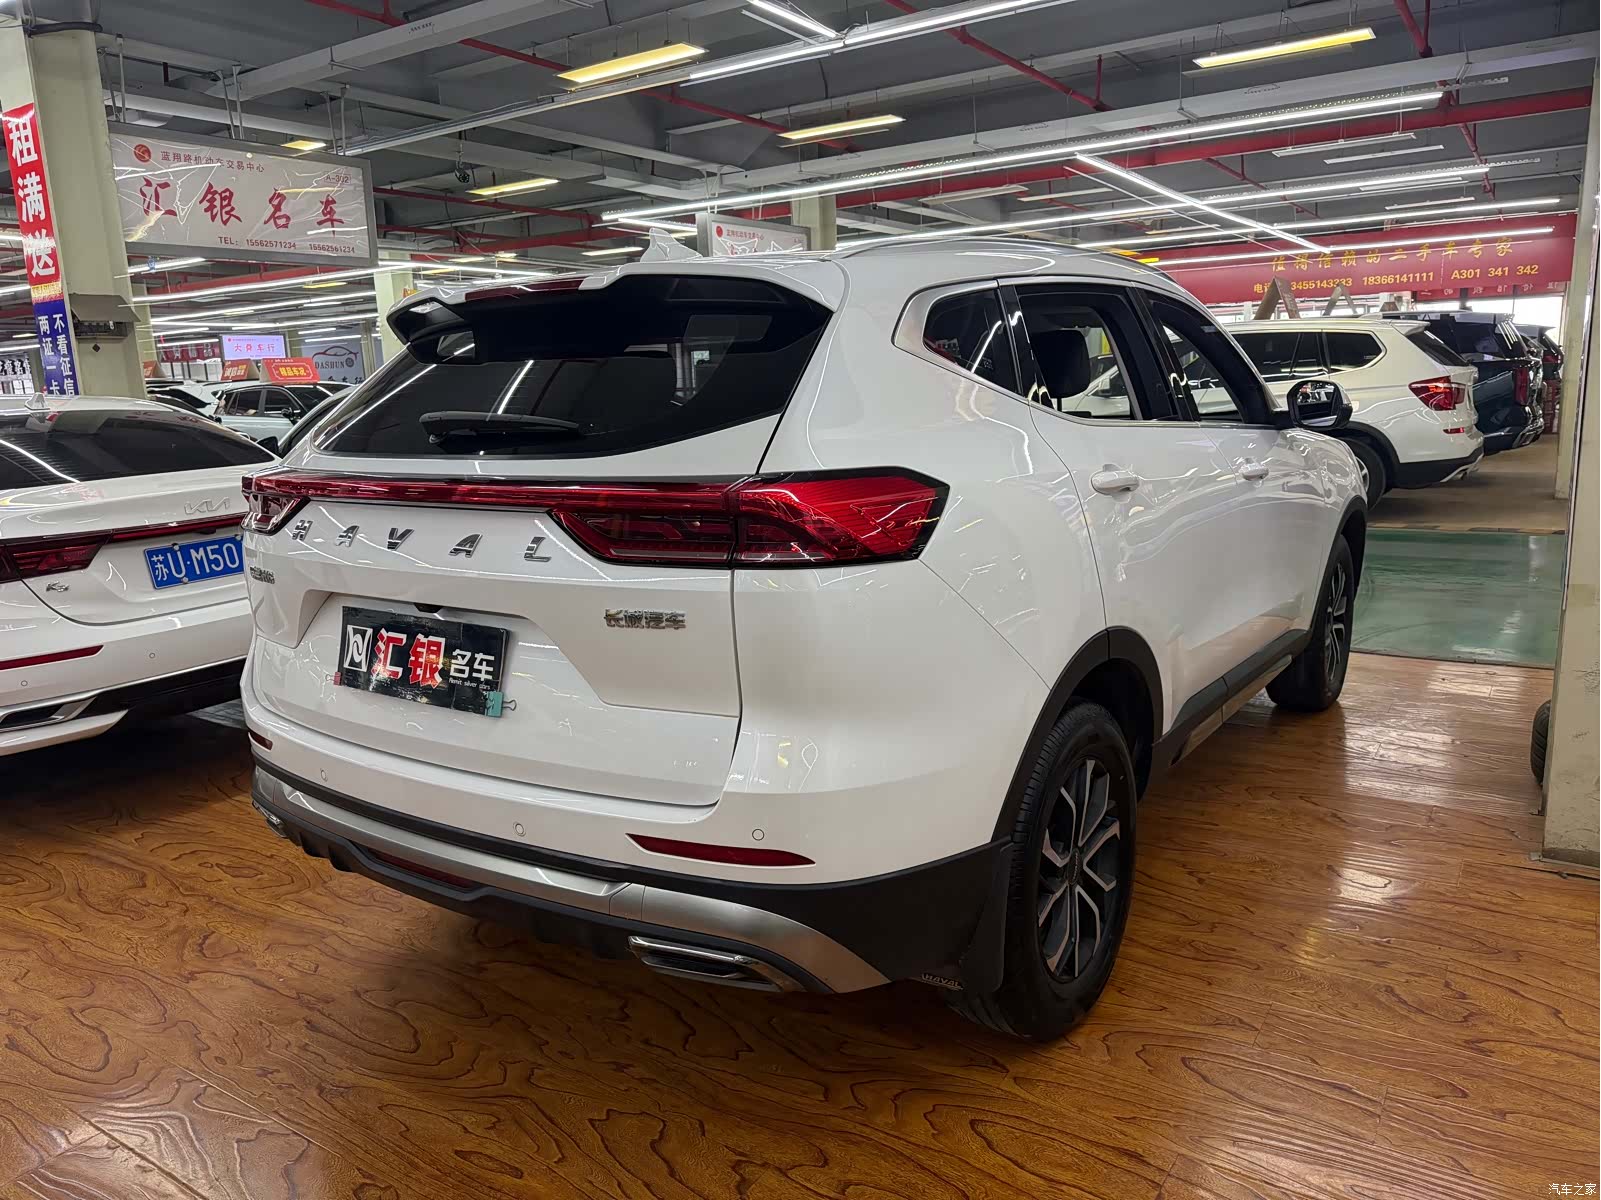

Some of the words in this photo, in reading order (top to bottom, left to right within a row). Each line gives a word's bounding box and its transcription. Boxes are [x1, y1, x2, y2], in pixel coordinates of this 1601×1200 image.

[161, 150, 265, 173] 蓝翔路机动车交易中心
[7, 117, 56, 278] 租满送
[140, 176, 345, 238] 汇银名车
[246, 238, 297, 249] 15562571234
[1272, 236, 1513, 272] 值得信赖的二手车专家
[1362, 271, 1434, 286] 18366141111
[1451, 268, 1481, 281] A301
[1487, 266, 1510, 278] 341
[1516, 264, 1539, 276] 342
[38, 315, 60, 395] 两证一卡
[53, 313, 75, 395] 不看征信
[314, 361, 346, 369] DASHUN
[292, 519, 552, 563] HAVAL
[371, 627, 495, 689] 汇银名车
